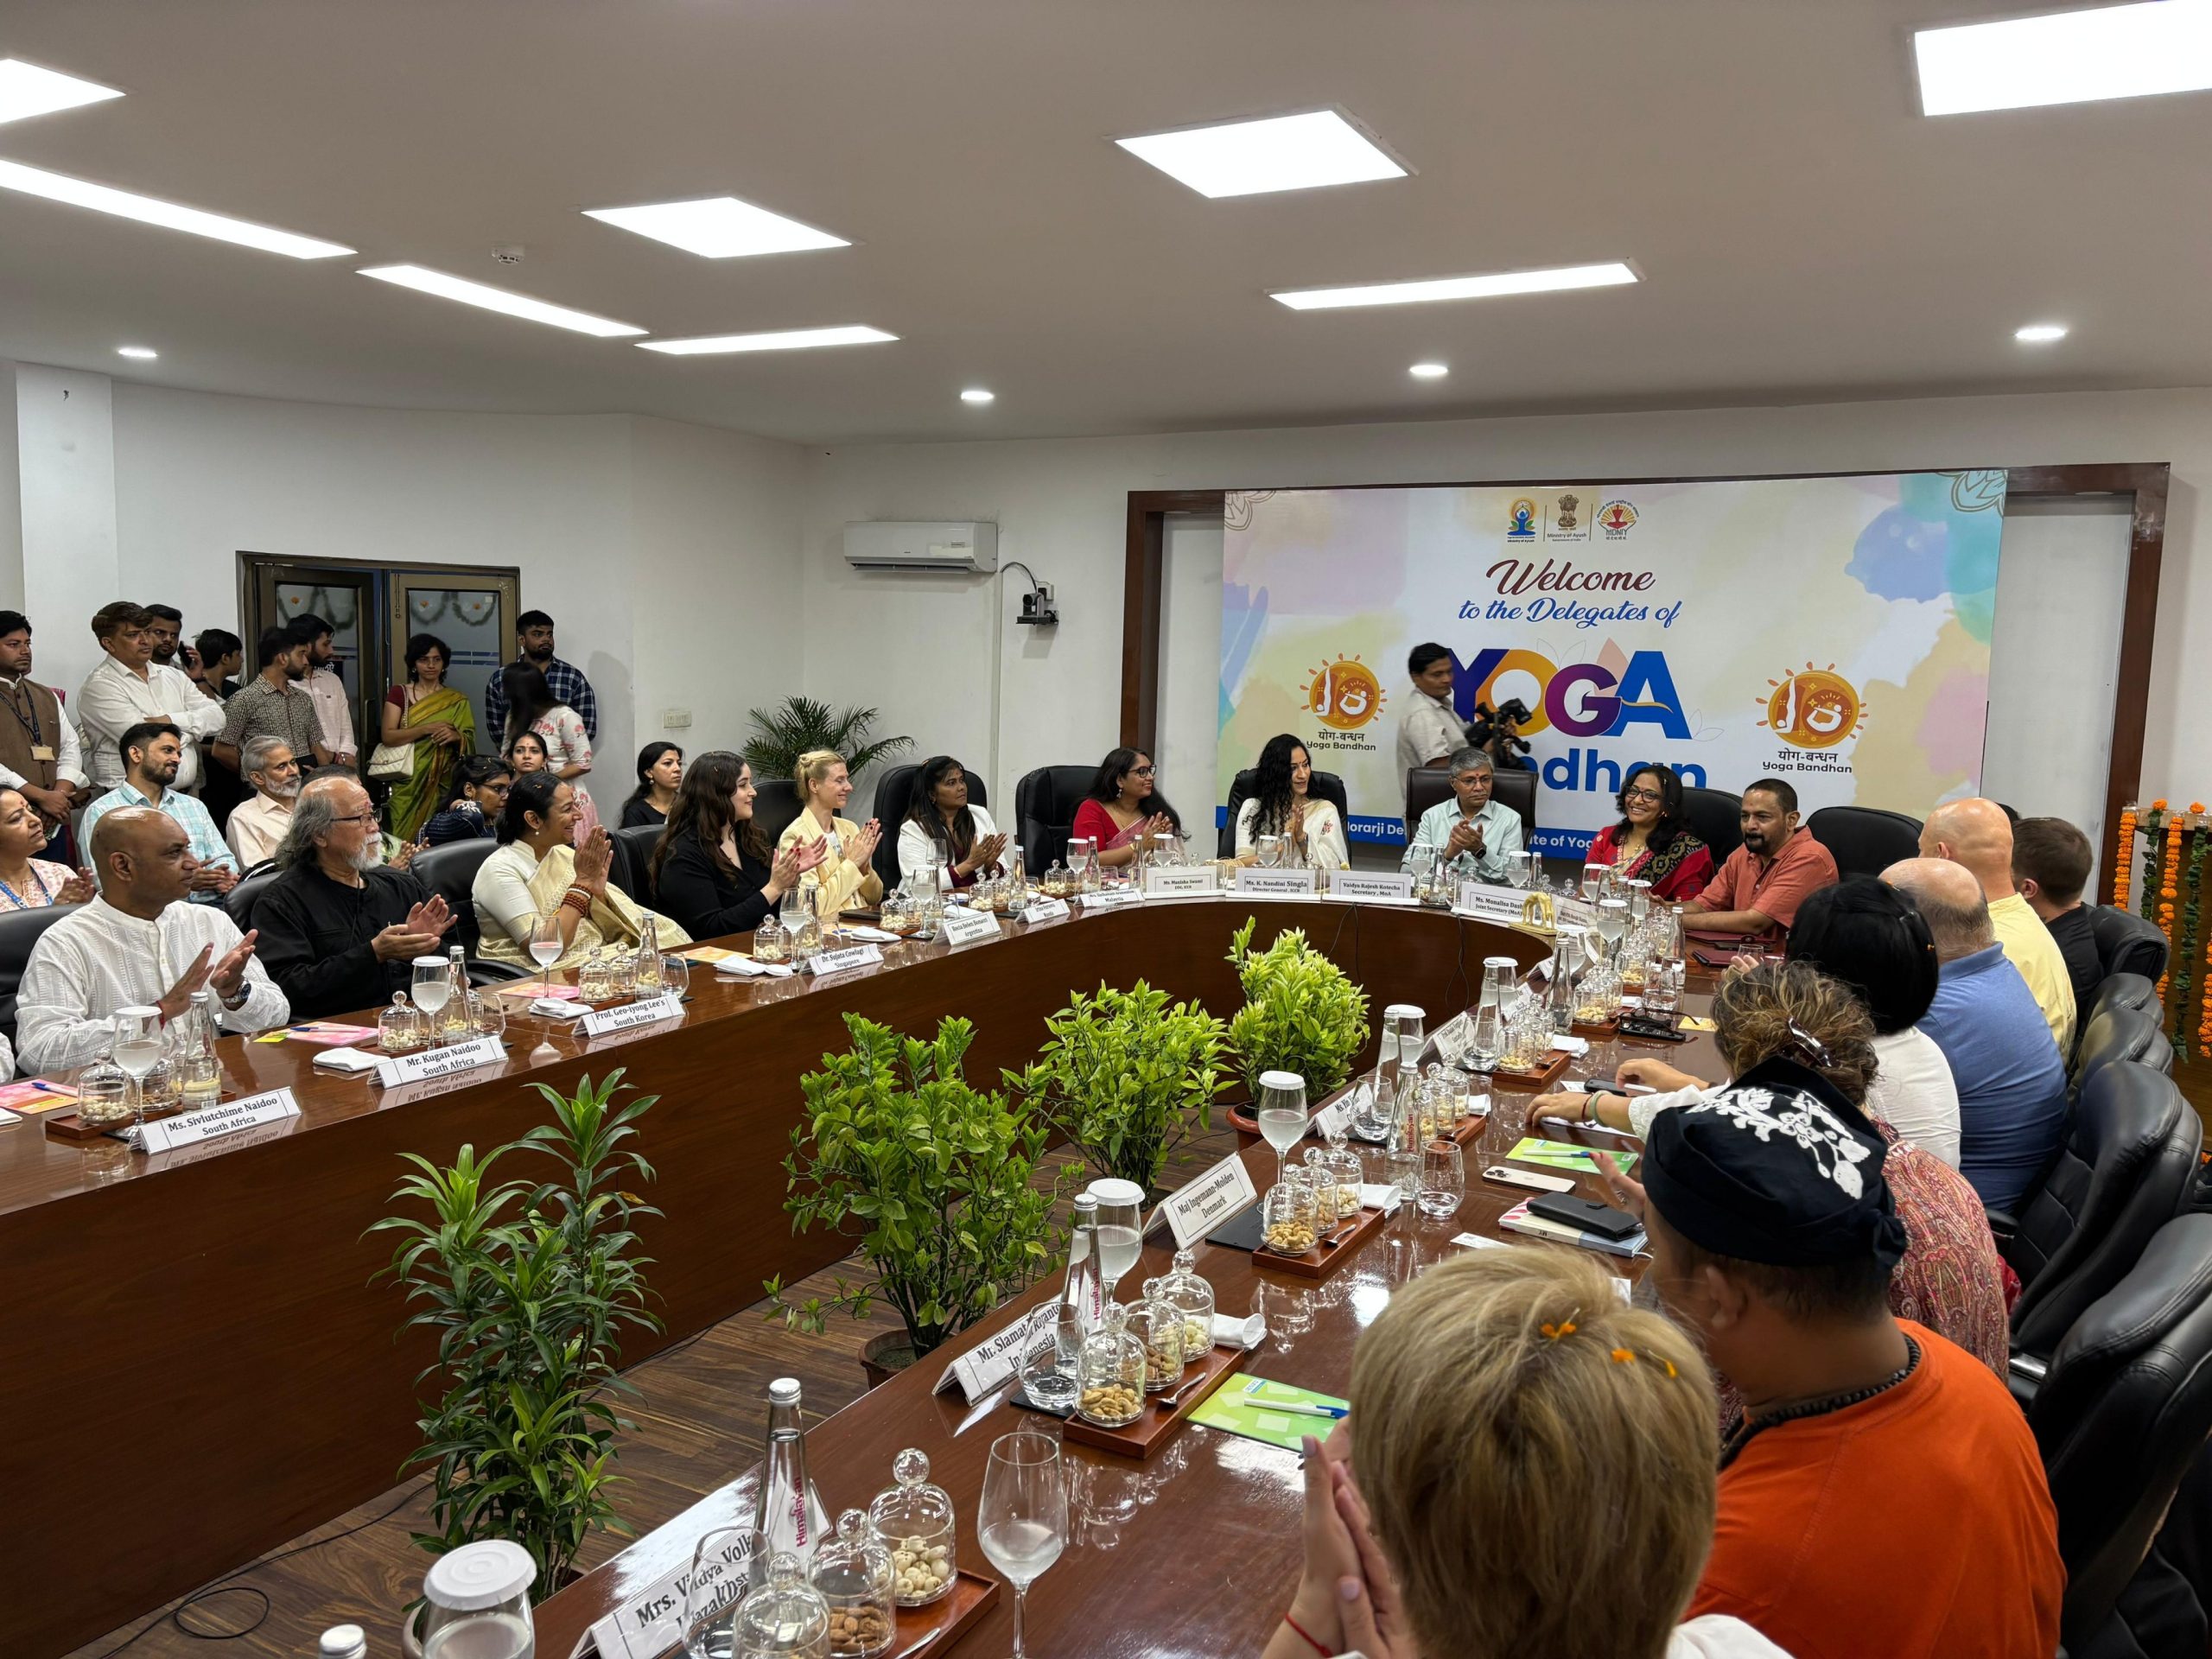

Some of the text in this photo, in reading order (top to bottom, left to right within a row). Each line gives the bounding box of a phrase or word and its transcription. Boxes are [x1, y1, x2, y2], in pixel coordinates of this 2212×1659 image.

[1486, 558, 1656, 595] Welcome
[1459, 597, 1683, 629] to the Delegates of
[1446, 648, 1694, 740] YOGA
[1306, 741, 1376, 751] Yoga Bandhan
[1763, 761, 1853, 773] Yoga Bandhan
[1347, 821, 1384, 836] orarji
[1550, 836, 1565, 847] of
[1567, 836, 1593, 851] Yog
[1485, 898, 1509, 906] Monalisa
[1487, 906, 1508, 914] Secretary
[830, 952, 845, 961] Sujata
[835, 958, 860, 968] Singapore
[595, 1011, 613, 1020] Prof.
[613, 1013, 656, 1027] South Korea
[406, 1043, 481, 1067] Mr. Kugan Naidoo
[423, 1058, 475, 1077] South Africa
[168, 1096, 277, 1133] Ms. Sivlutchime Naidoo
[202, 1116, 257, 1135] South Africa
[1407, 1114, 1415, 1153] Himalayan
[1201, 1195, 1227, 1218] Denmark
[976, 1346, 996, 1363] Mr.
[994, 1325, 1028, 1352] Slamat
[794, 1477, 808, 1548] Himalayan
[635, 1594, 677, 1629] Mrs.
